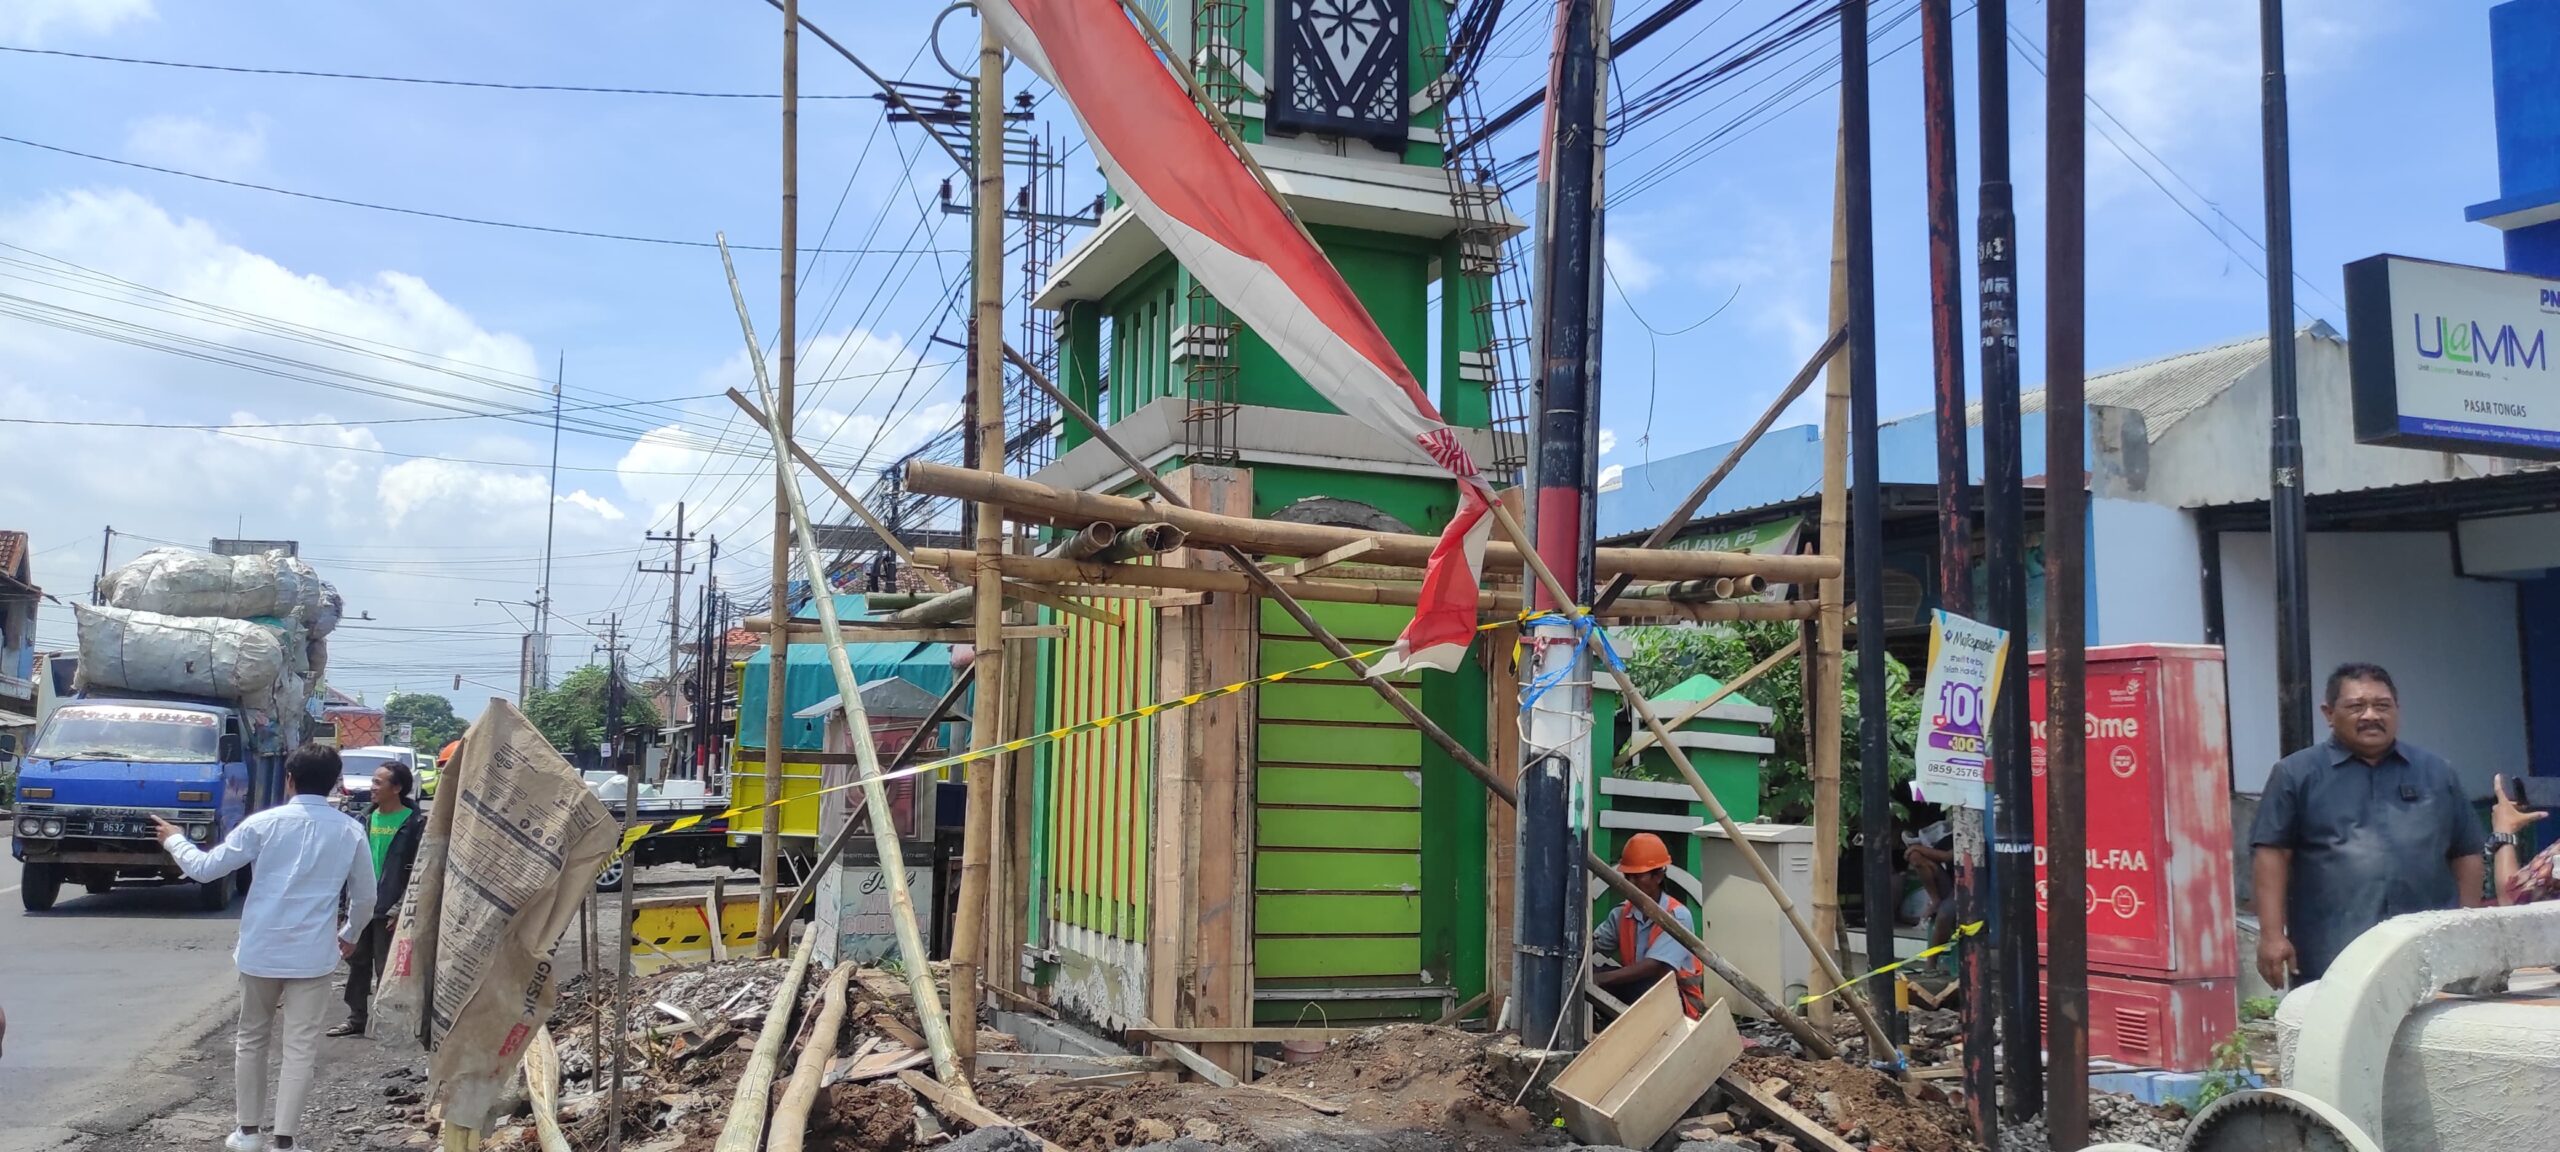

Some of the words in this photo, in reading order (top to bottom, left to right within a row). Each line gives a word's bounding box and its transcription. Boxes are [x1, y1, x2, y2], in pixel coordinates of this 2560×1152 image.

[2464, 399, 2492, 415] PASAR
[2493, 402, 2527, 418] TONGAS
[1695, 538, 1729, 551] JAYA
[103, 822, 126, 833] 8632
[522, 960, 552, 1018] GRESIK
